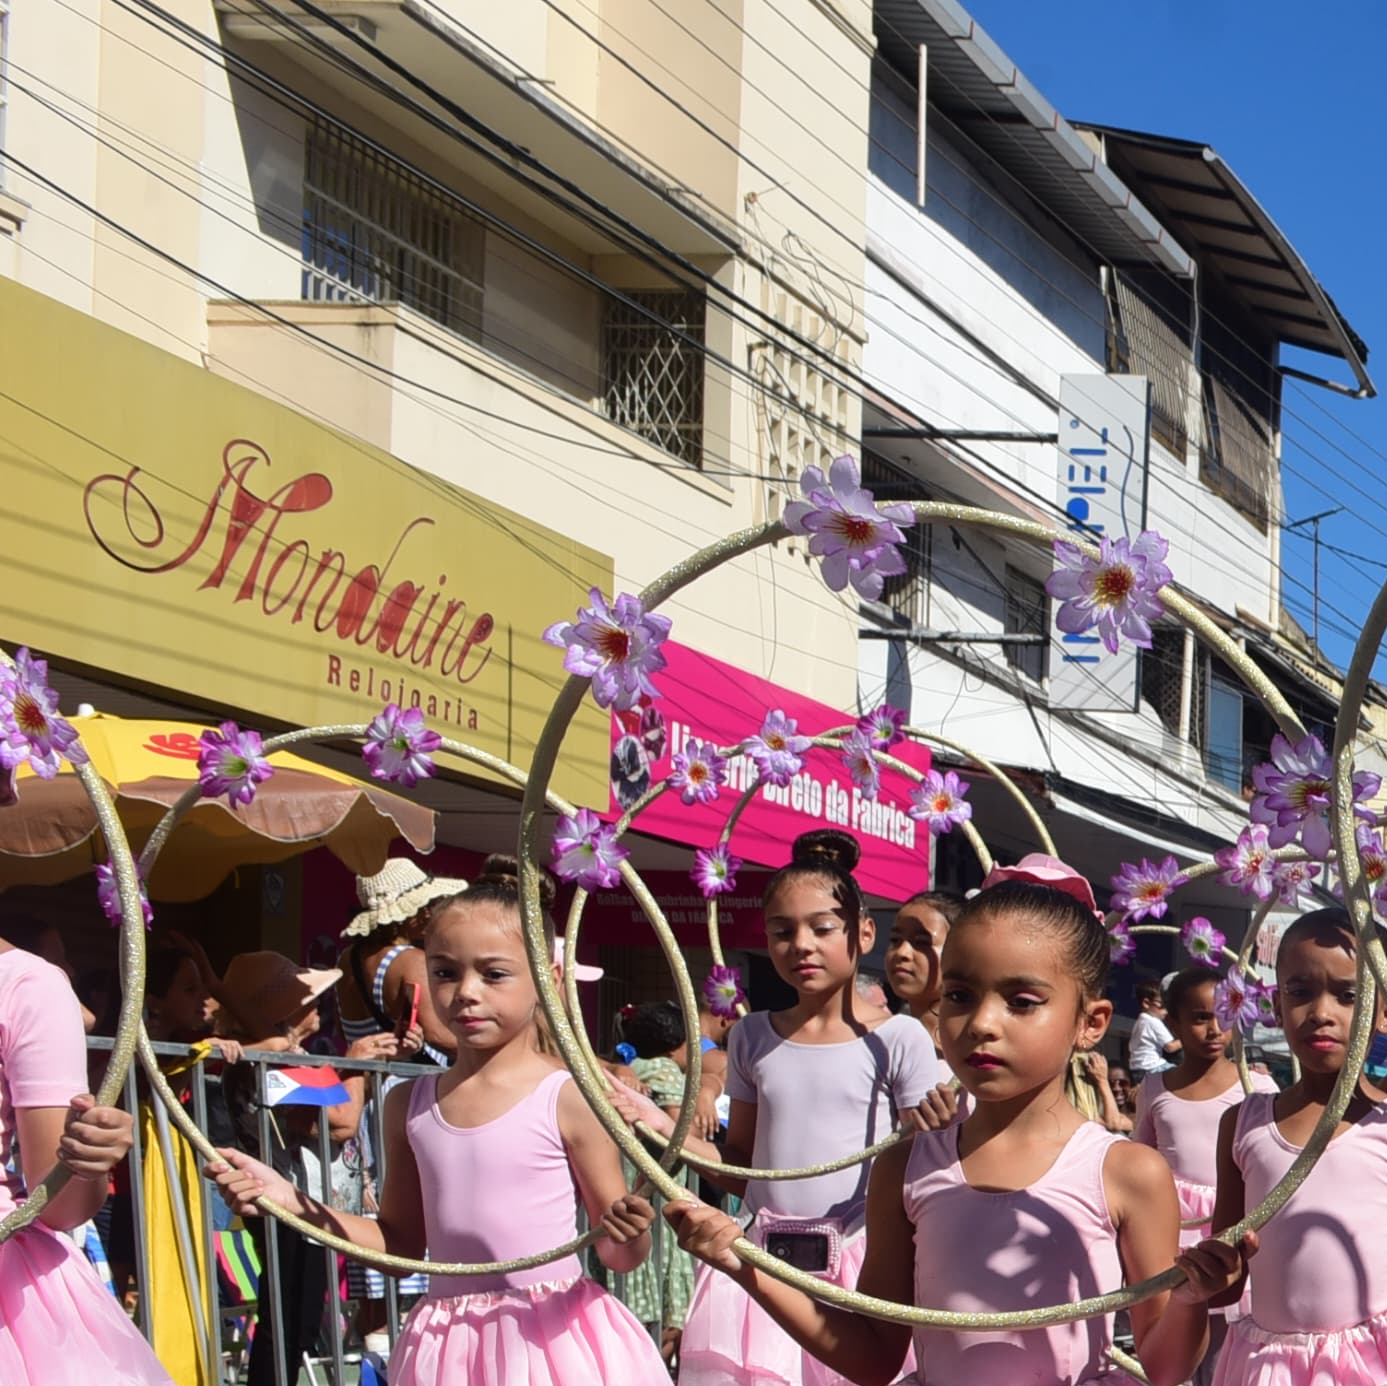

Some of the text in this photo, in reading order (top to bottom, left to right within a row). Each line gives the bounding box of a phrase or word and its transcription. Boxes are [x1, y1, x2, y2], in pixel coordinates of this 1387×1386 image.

[83, 439, 494, 683] Mondaine
[328, 653, 478, 730] Relojoaria
[825, 780, 849, 826] da
[852, 787, 915, 849] Fabrica
